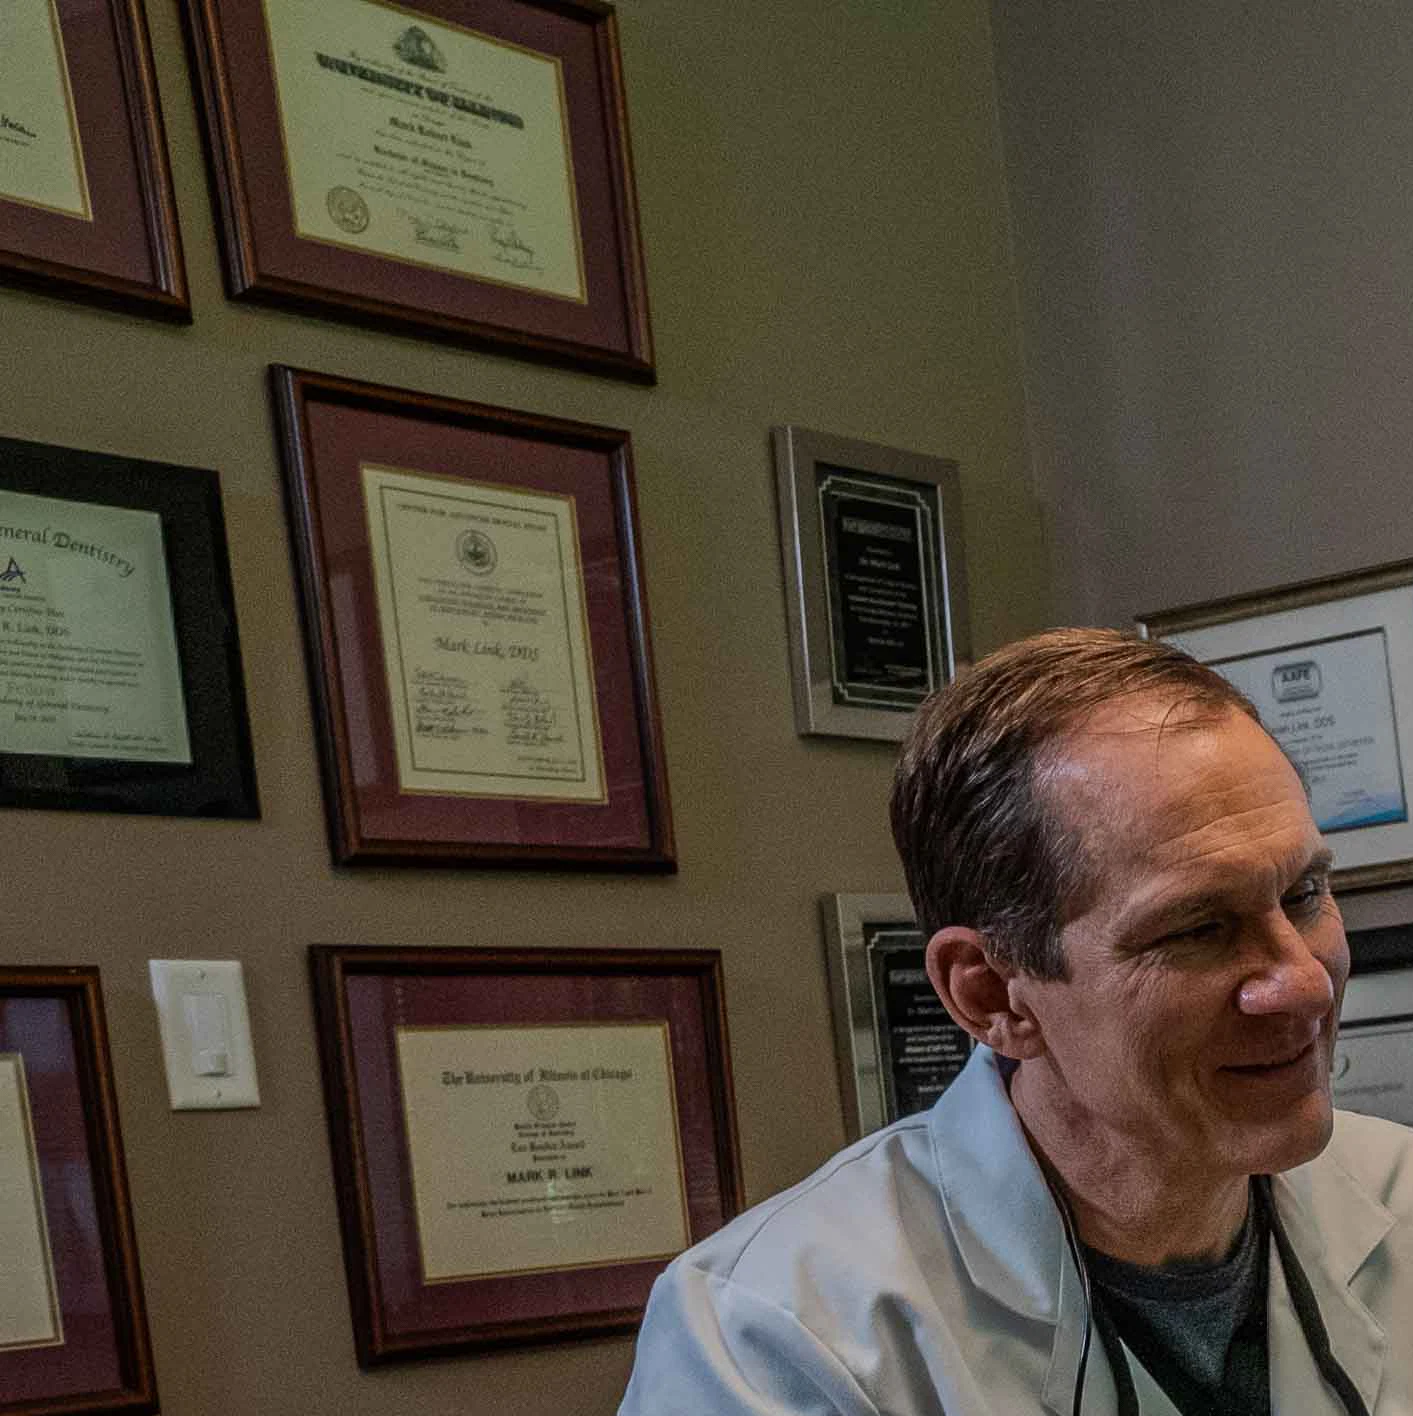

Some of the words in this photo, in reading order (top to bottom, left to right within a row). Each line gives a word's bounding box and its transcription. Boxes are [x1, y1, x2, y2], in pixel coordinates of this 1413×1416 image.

[0, 525, 49, 545] neral
[53, 531, 136, 578] Dentistry
[441, 1070, 464, 1086] The
[465, 1070, 521, 1085] University
[523, 1068, 534, 1083] of
[538, 1067, 578, 1082] Illinois
[592, 1065, 633, 1081] Chicago
[506, 1168, 543, 1184] MARK
[564, 1166, 593, 1181] LINK
